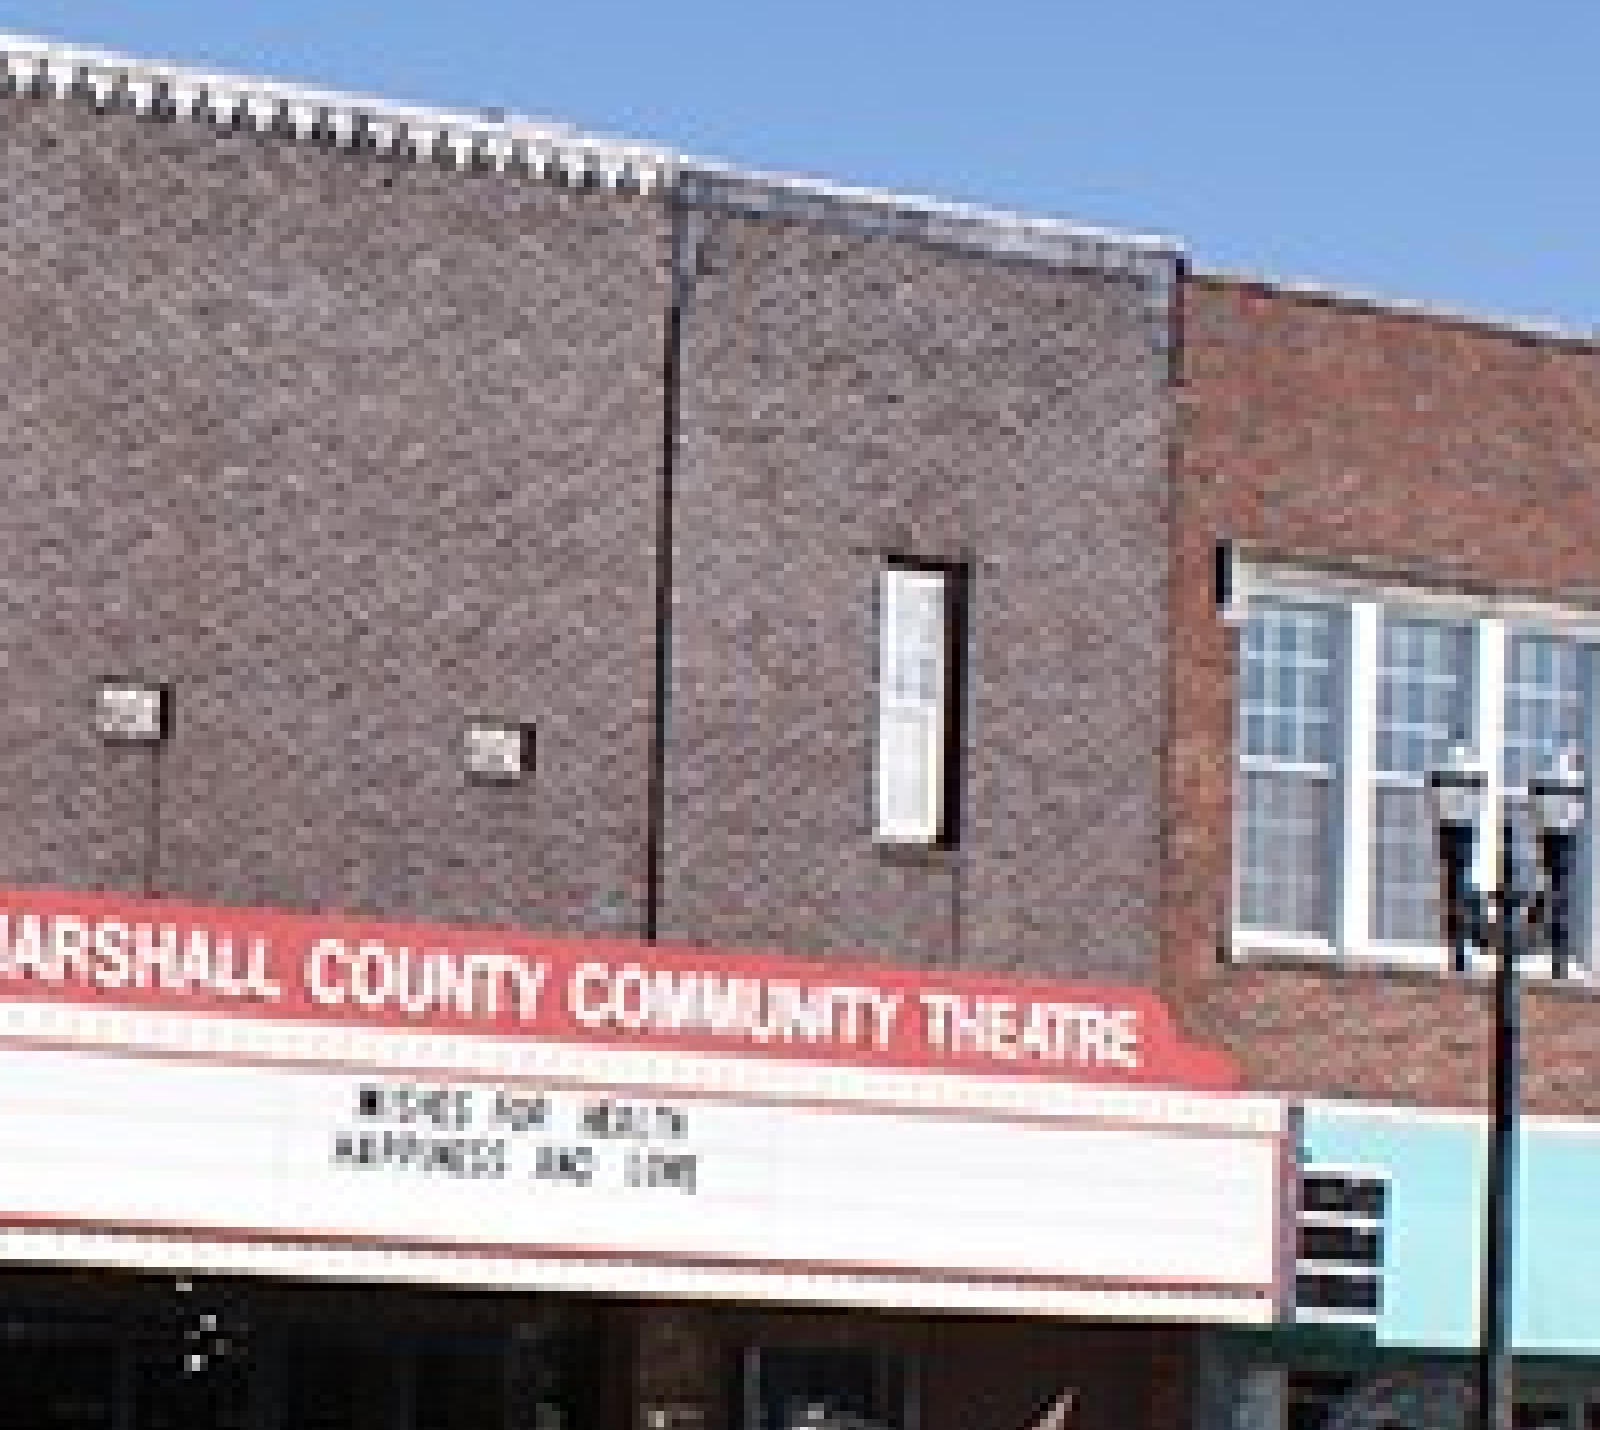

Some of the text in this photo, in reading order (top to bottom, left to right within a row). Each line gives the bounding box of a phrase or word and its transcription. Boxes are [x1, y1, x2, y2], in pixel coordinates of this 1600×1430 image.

[305, 938, 544, 1021] COUNTY
[569, 963, 902, 1048] COMMUNITY
[921, 994, 1142, 1068] THEATRE
[359, 1086, 687, 1141] WISHES FOR HEALTH
[332, 1132, 700, 1194] HAPPINESS AND LOVE
